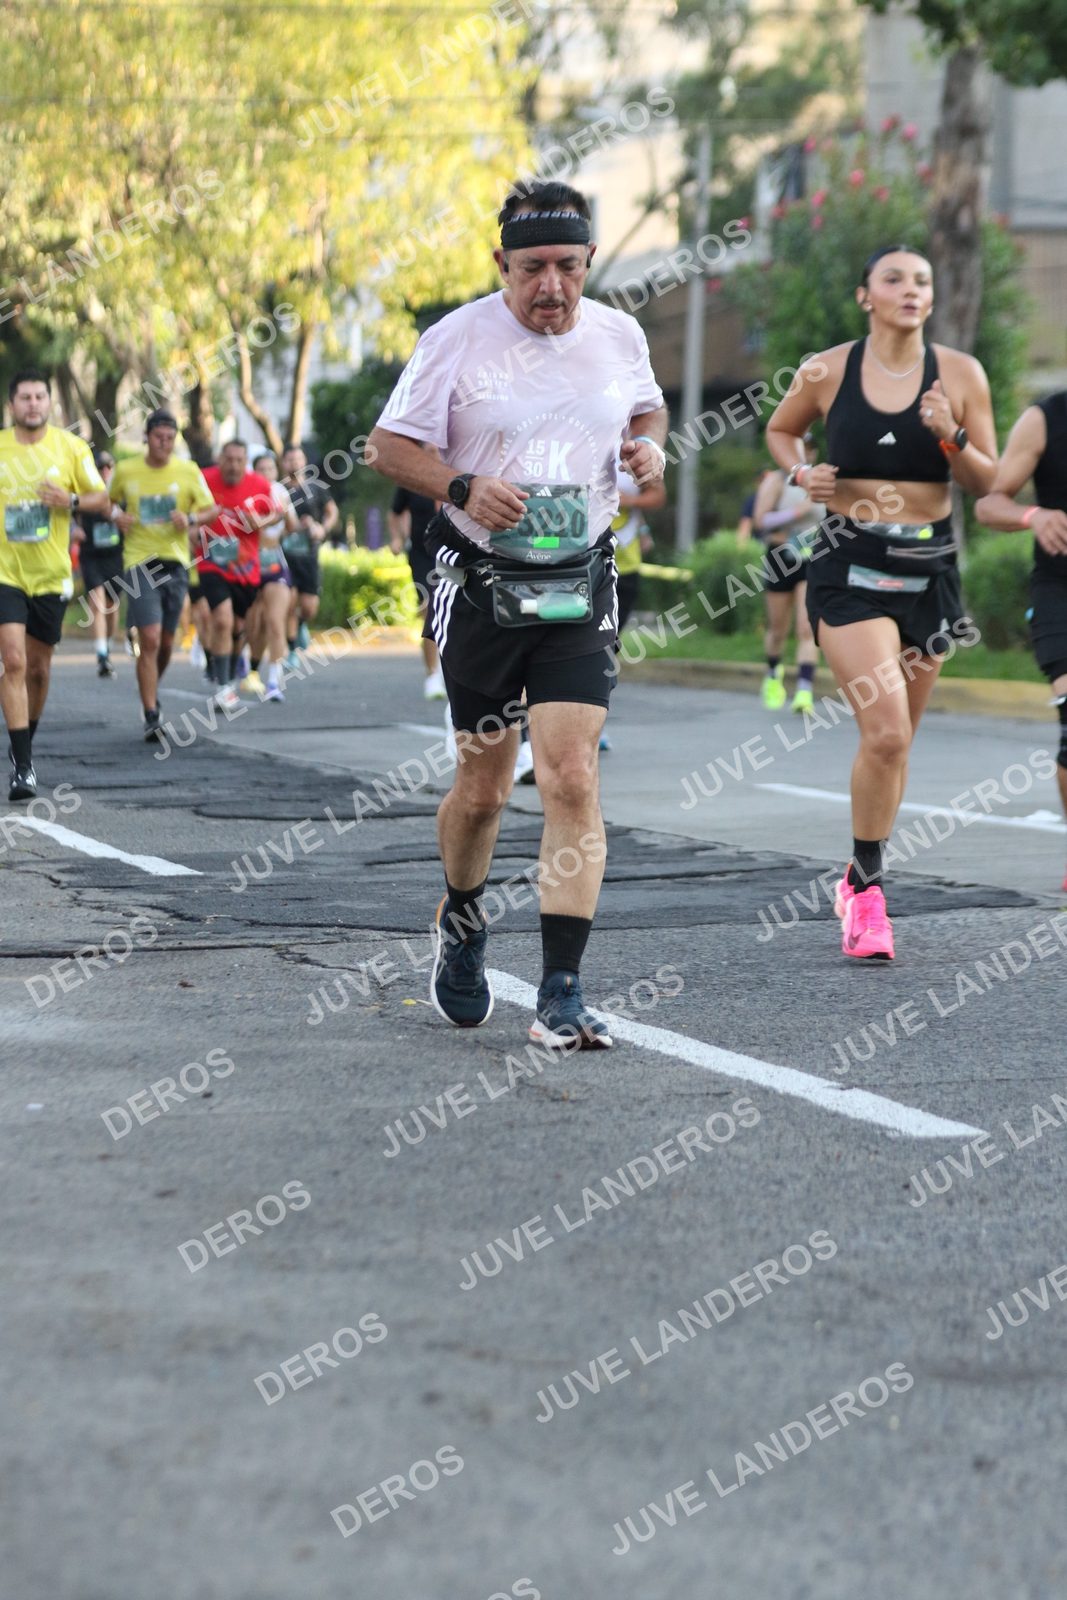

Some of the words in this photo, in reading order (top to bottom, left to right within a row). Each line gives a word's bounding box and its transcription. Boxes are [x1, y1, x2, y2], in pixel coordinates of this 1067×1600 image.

[522, 460, 544, 478] 30
[526, 438, 546, 456] 15
[547, 439, 574, 482] K
